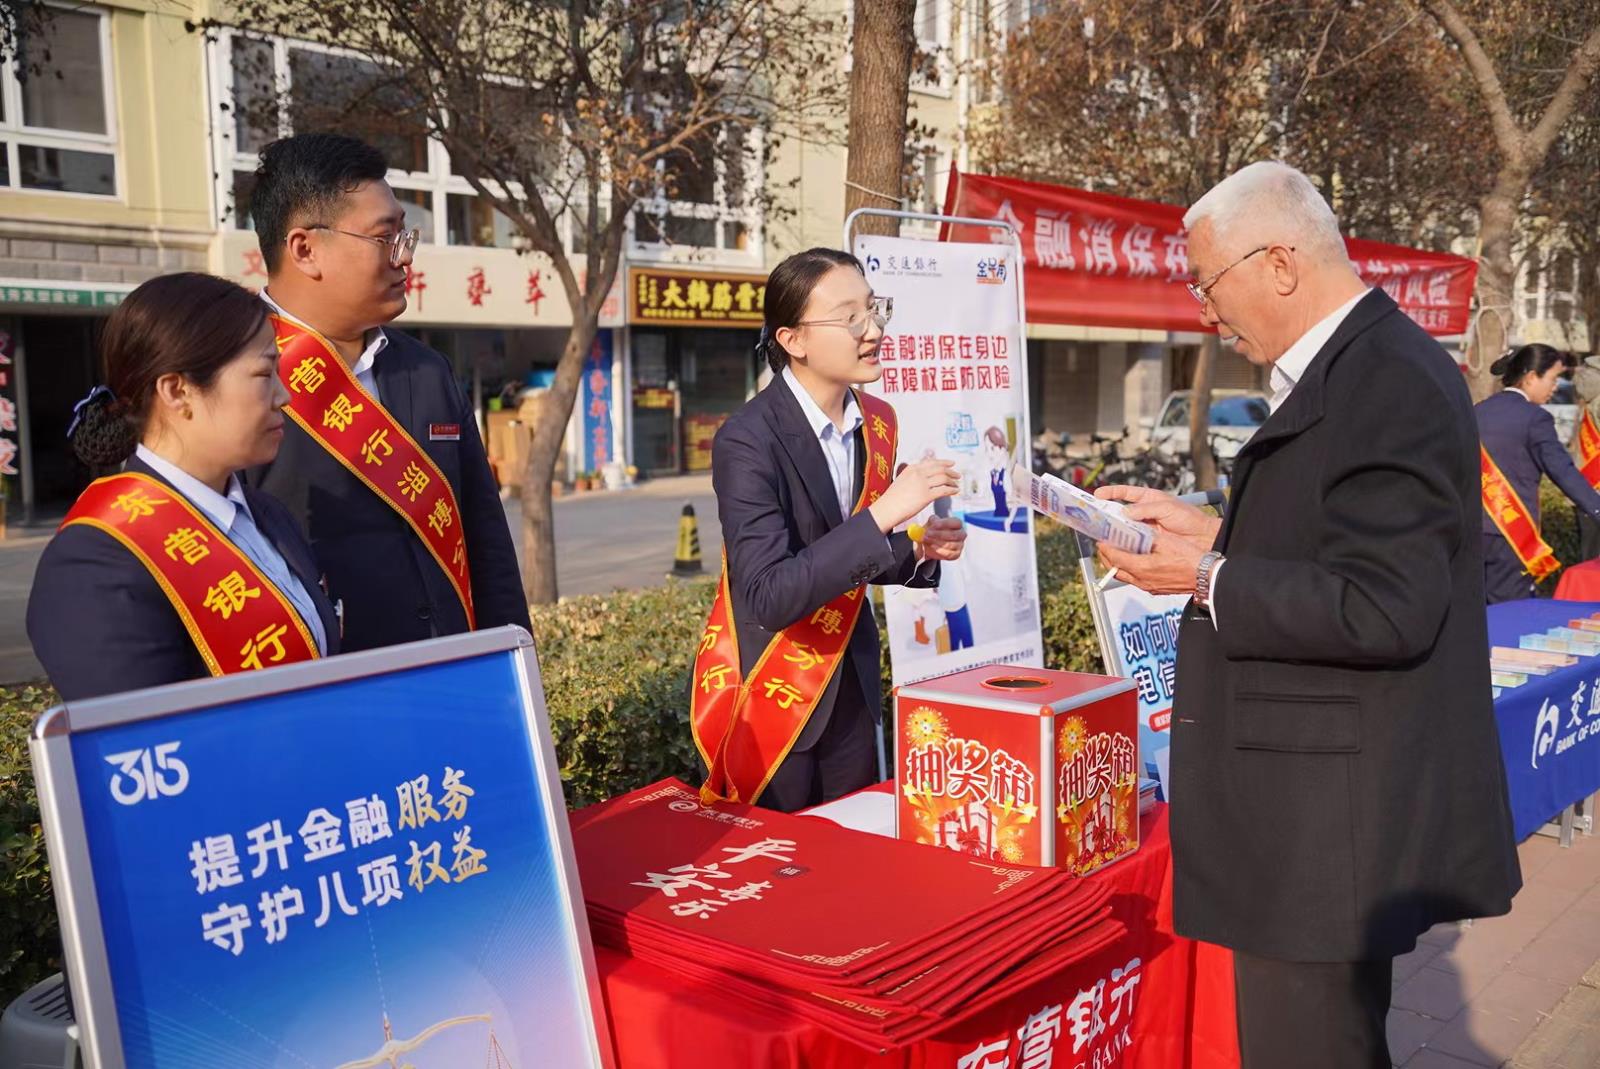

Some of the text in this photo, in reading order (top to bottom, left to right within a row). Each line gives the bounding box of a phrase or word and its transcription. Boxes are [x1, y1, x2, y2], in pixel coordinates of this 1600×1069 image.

[880, 335, 1009, 362] 金融消保在身边
[882, 364, 1011, 393] 保障权益防风险
[110, 488, 289, 670] 东营银行
[105, 740, 190, 805] 315
[907, 738, 1034, 809] 抽奖箱
[1061, 733, 1135, 809] 抽奖箱
[189, 766, 475, 895] 提升金融服务
[201, 825, 488, 957] 守护八项权益
